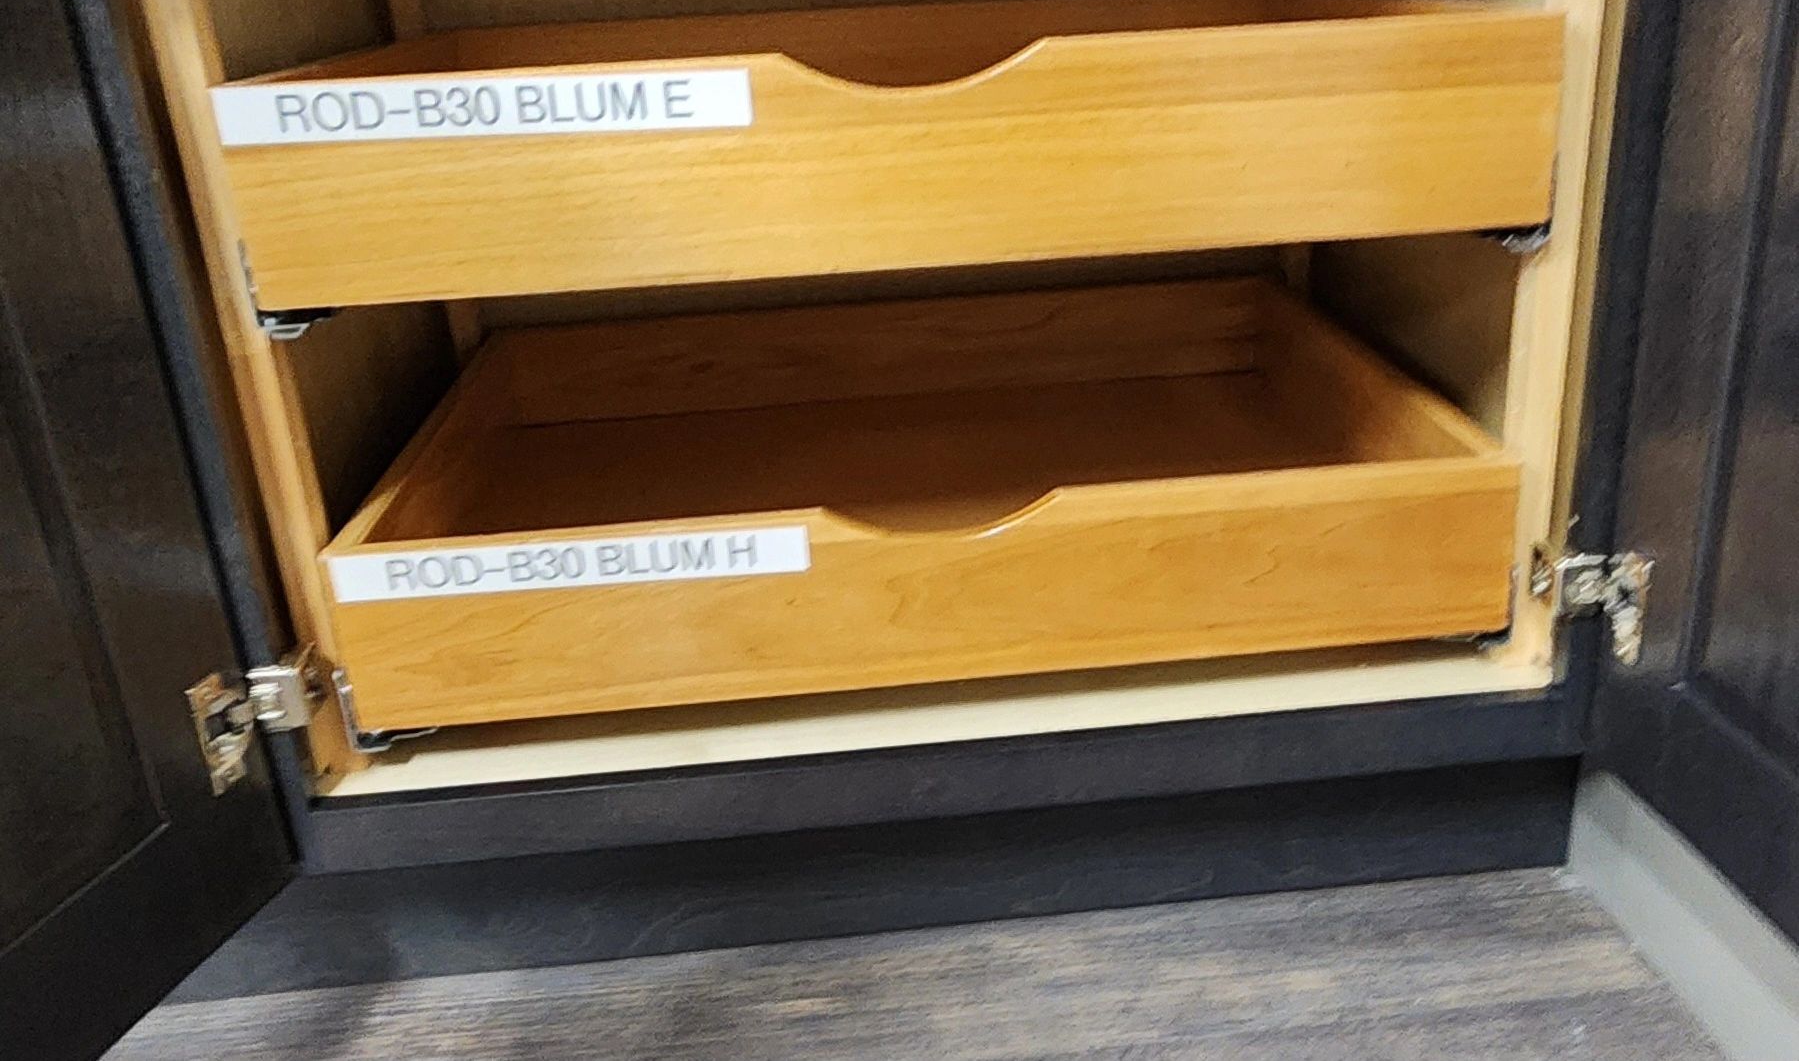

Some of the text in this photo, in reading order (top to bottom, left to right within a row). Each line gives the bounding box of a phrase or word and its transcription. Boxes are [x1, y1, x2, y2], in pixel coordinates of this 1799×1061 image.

[275, 79, 694, 133] ROD-B30 BLUM E
[384, 535, 758, 591] ROD-B30 BLUM H
